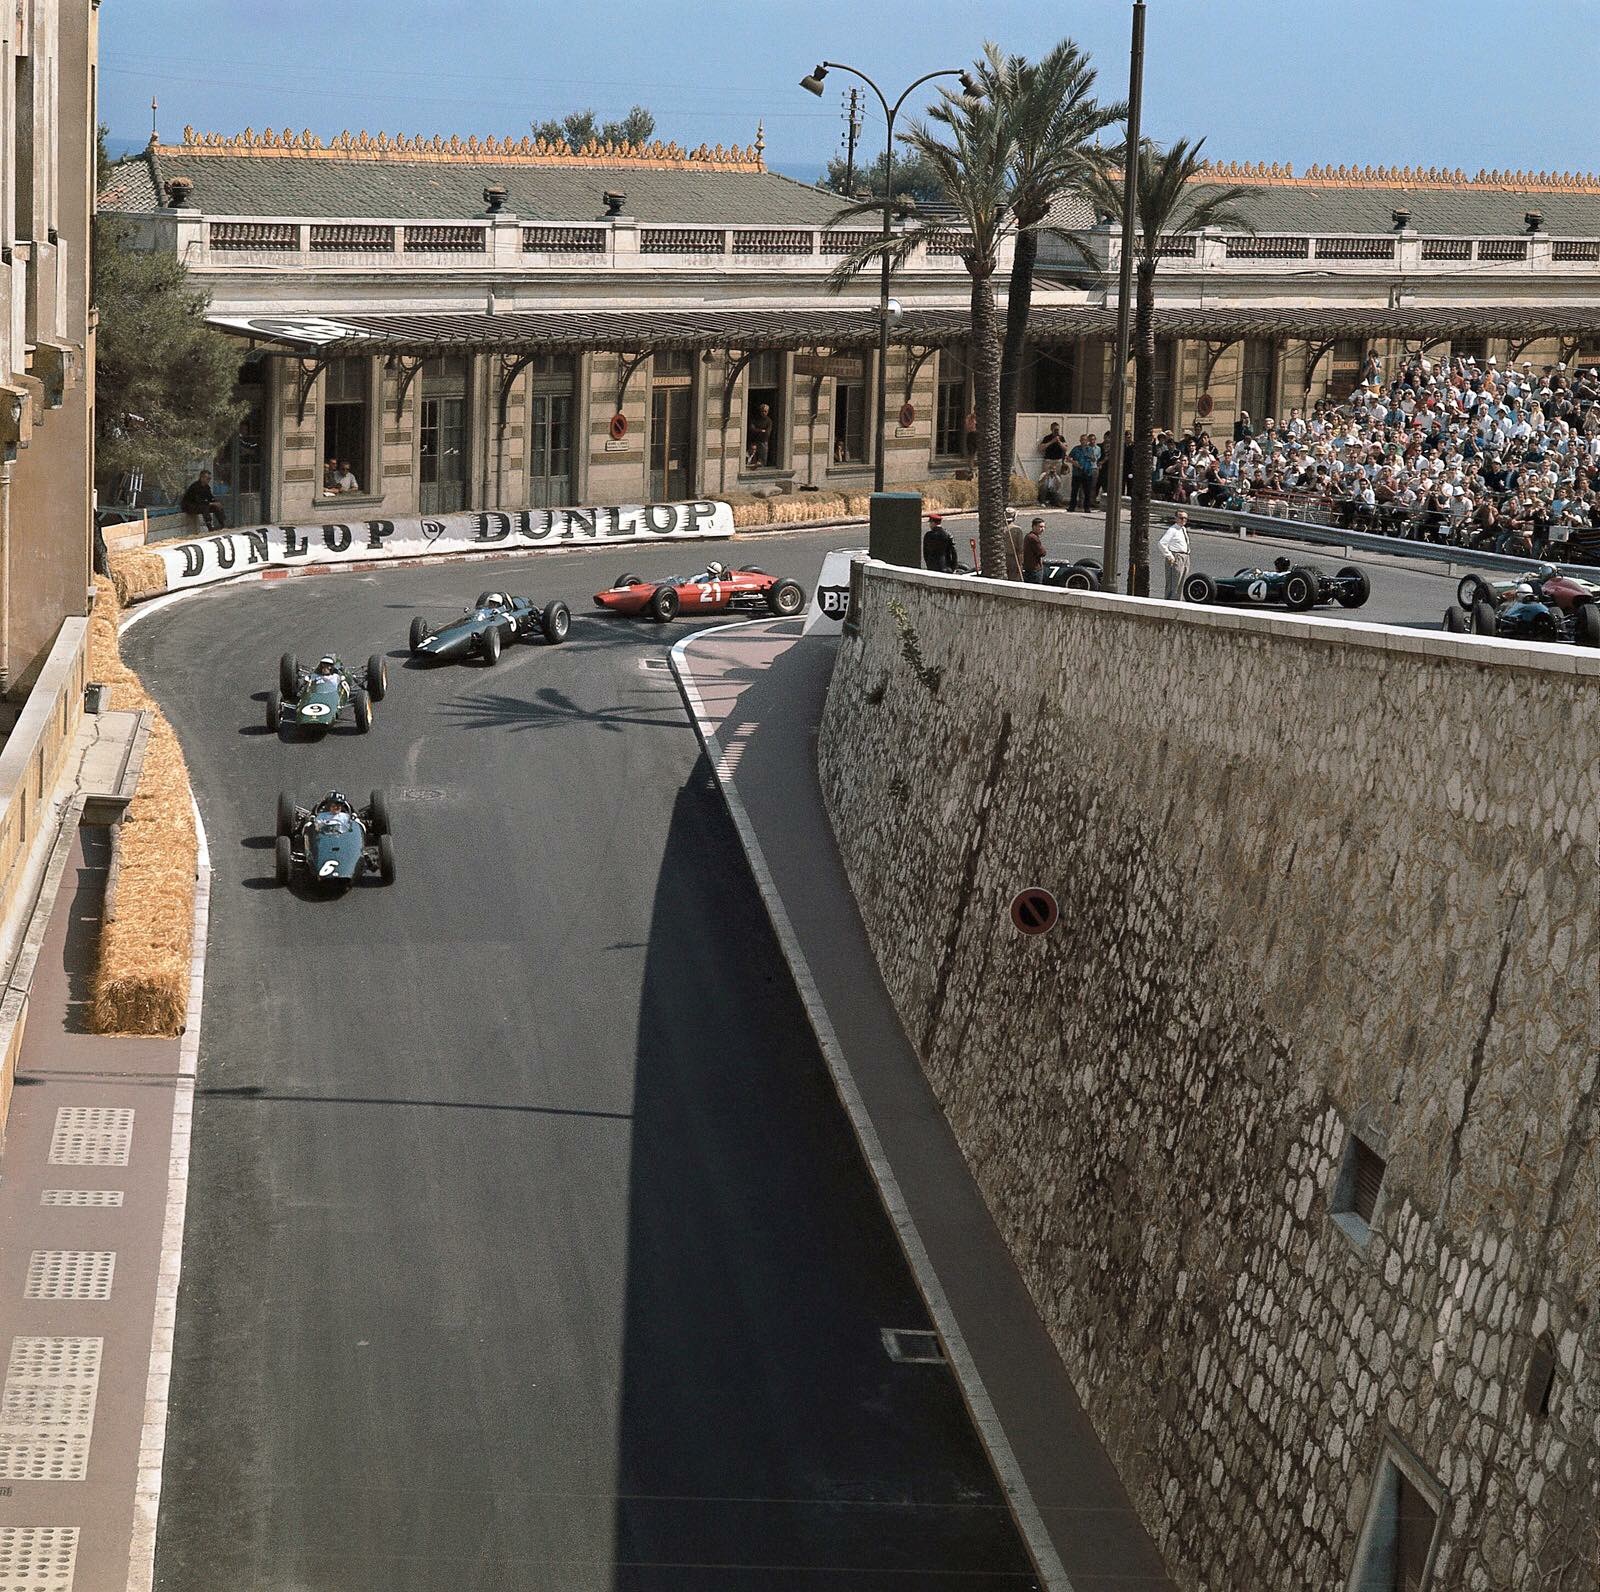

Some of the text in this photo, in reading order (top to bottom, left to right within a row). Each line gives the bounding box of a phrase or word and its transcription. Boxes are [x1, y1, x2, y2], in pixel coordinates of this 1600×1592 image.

[176, 519, 395, 577] DUNLOP
[470, 501, 716, 543] DUNLOP
[1049, 566, 1060, 578] 7
[696, 582, 721, 602] 21
[1252, 582, 1262, 598] 4
[310, 705, 322, 713] 9
[319, 860, 339, 876] 6
